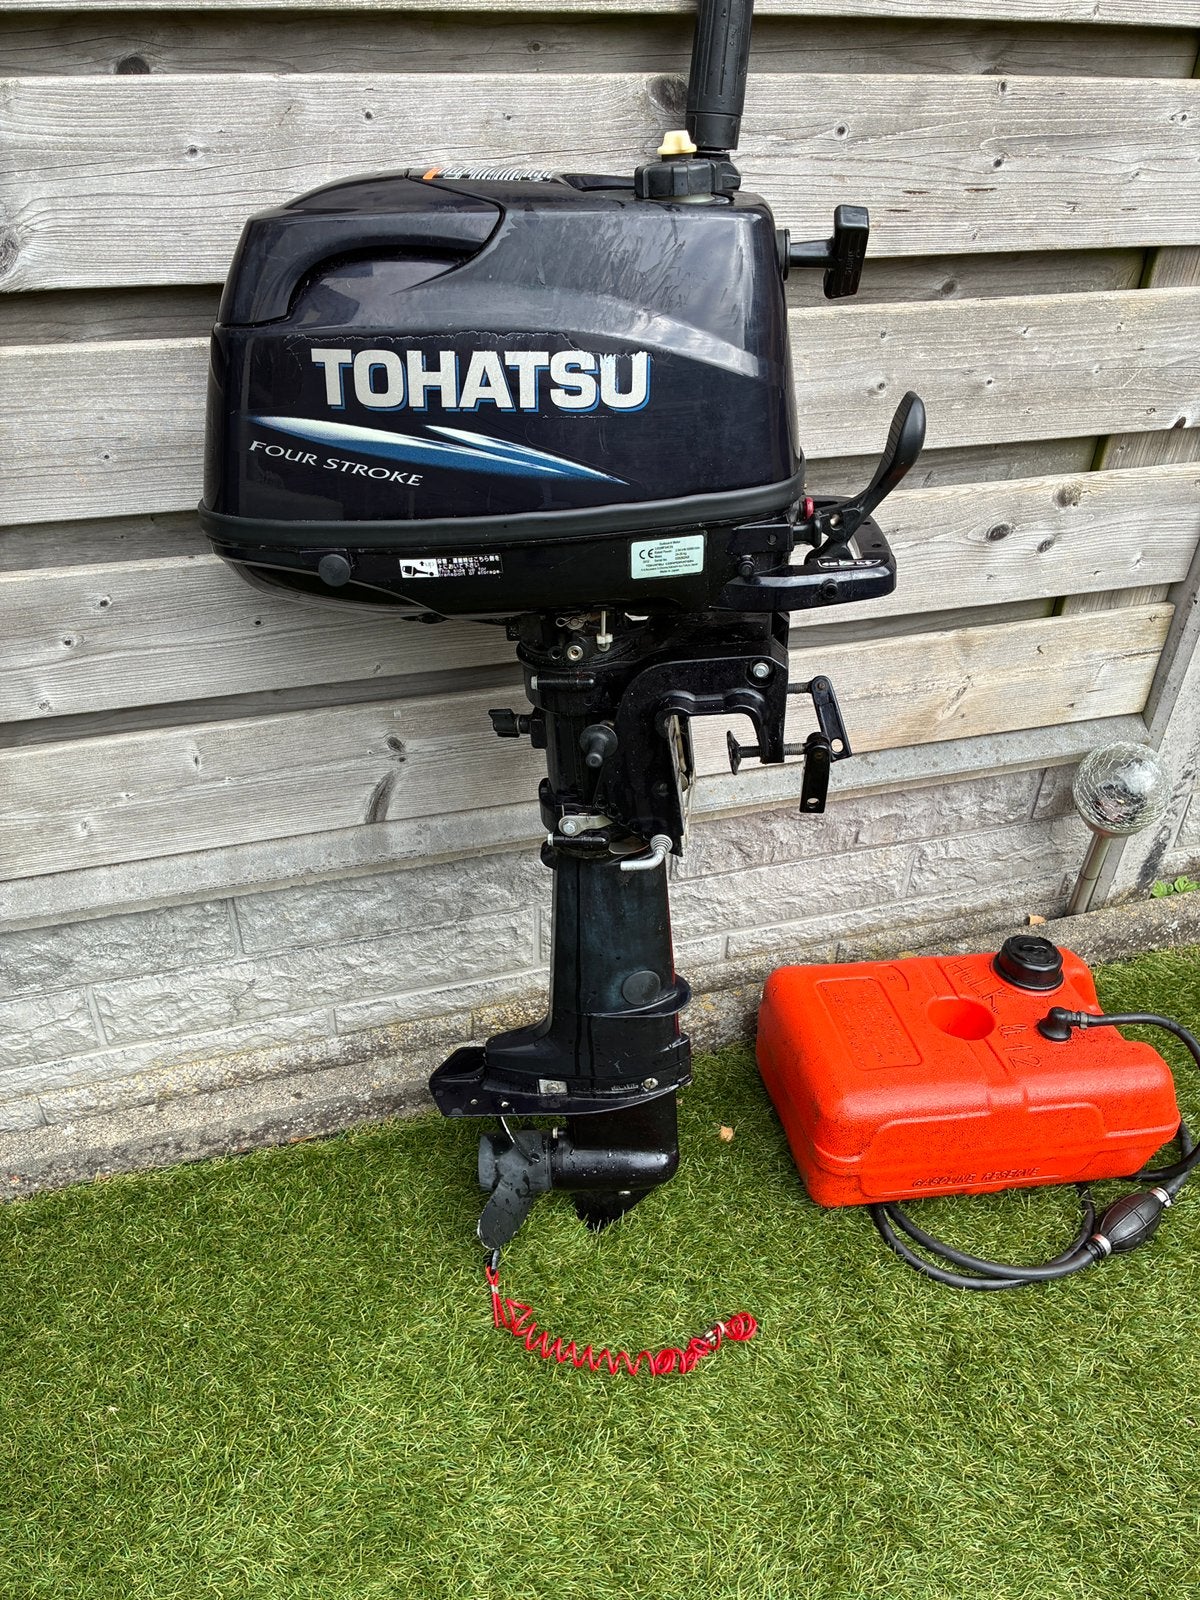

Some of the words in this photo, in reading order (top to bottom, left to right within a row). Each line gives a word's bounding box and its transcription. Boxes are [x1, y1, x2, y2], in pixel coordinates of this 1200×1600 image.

[311, 348, 651, 412] TOHATSU
[249, 440, 318, 466] FOUR
[322, 457, 423, 487] STROKE
